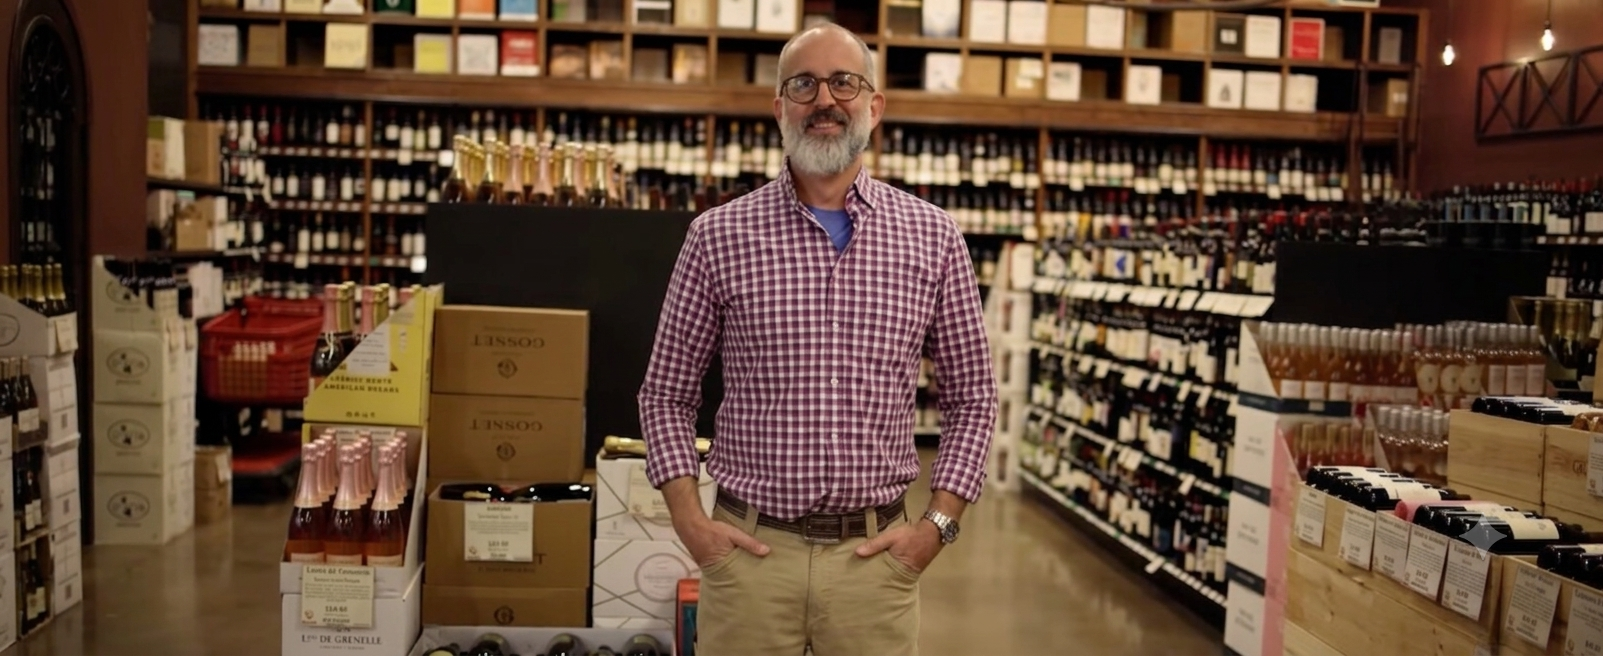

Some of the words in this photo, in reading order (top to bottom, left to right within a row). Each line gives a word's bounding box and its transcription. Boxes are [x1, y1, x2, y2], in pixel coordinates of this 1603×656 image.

[472, 334, 545, 349] GOSSET
[469, 419, 543, 432] GOSSET
[319, 635, 333, 643] DE
[334, 635, 382, 645] GRENELLE
